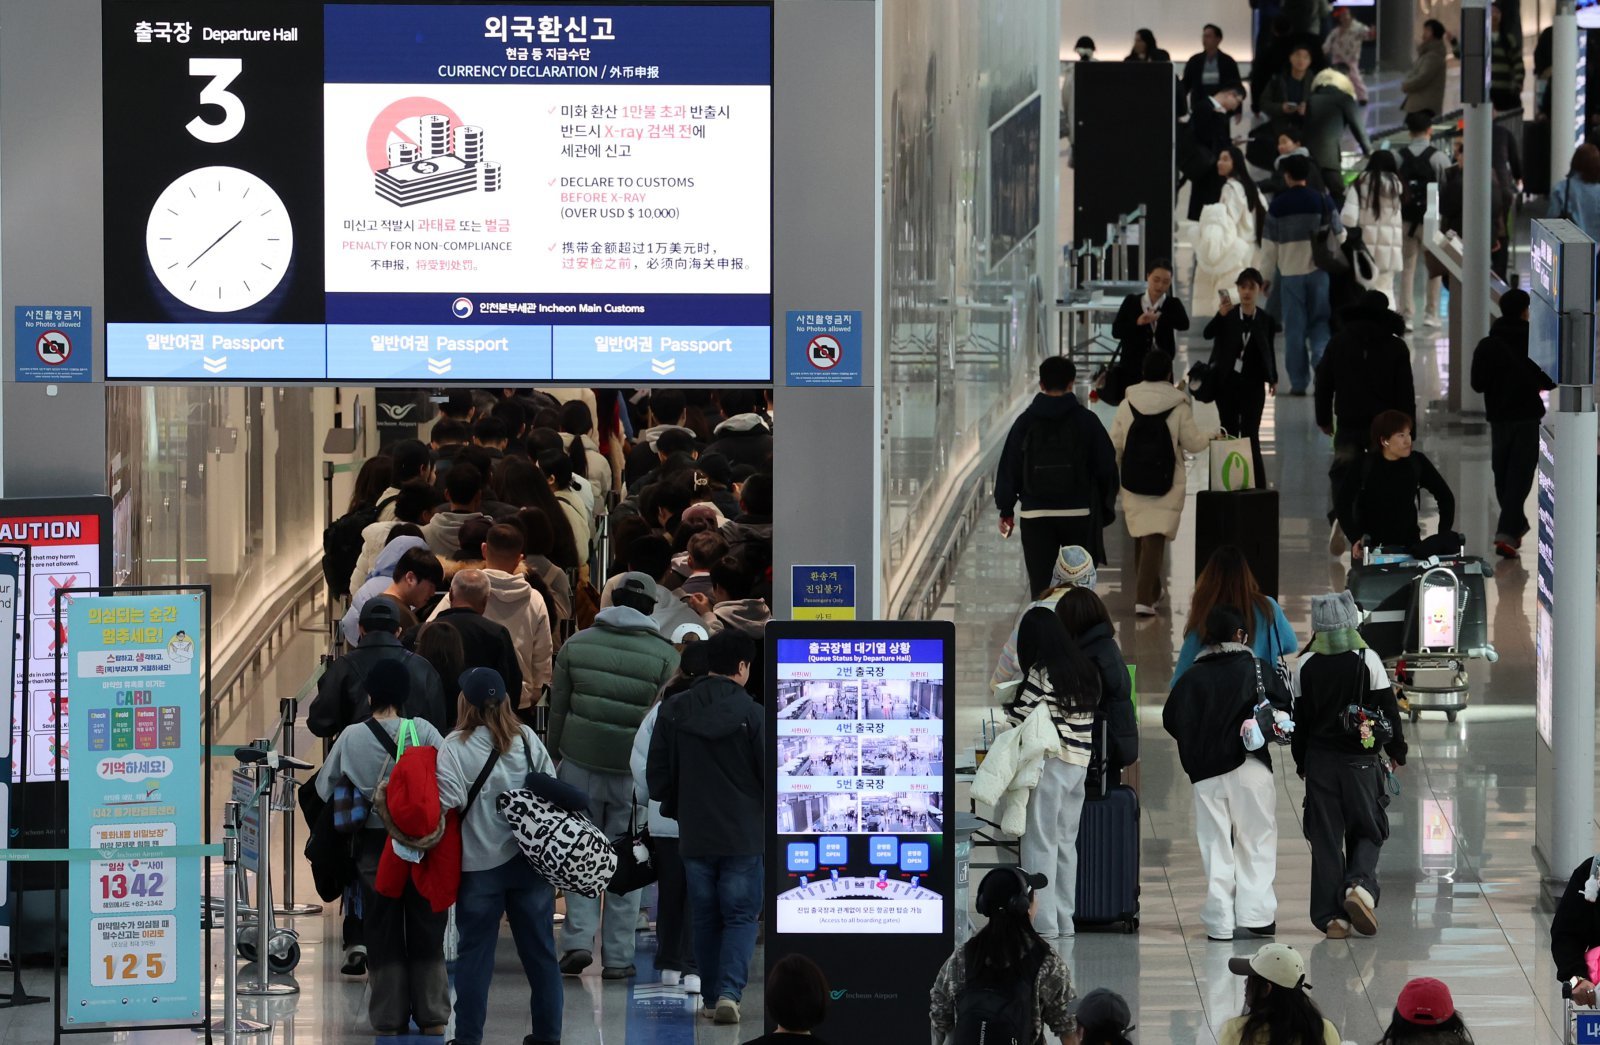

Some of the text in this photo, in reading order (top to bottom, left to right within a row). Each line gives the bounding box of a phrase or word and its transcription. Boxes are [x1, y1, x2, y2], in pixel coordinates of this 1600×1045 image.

[134, 21, 192, 43] 출국장
[484, 15, 616, 43] 외국환신고
[202, 27, 298, 44] Departure Hall
[506, 48, 591, 60] 현금 등 지급수단
[438, 65, 508, 78] CURRENCY
[510, 65, 598, 78] DECLARATION
[609, 65, 660, 79] 外币申报
[185, 57, 247, 144] 3
[561, 105, 731, 120] 미화 환산 1만불 초과 반출시
[560, 124, 706, 141] 반드시 X-ray 검색 전에
[560, 143, 632, 158] 세관에 신고
[560, 177, 695, 188] DECLARE TO CUSTOMS
[560, 192, 646, 203] BEFORE X-RAY
[560, 207, 680, 219] (OVER USD $ 10,000)
[343, 218, 511, 233] 미신고 적발시 과태료 또는 벌금
[342, 240, 512, 251] PENALTY FOR NON-COMPLIANCE
[479, 302, 645, 314] 인천본부세관 Incheon Main Customs
[25, 310, 82, 320] 사진촬영금지
[796, 315, 852, 325] 사진촬영금지
[145, 334, 284, 354] 일반여권 Passport
[370, 335, 509, 353] 일반여권 Passport
[595, 335, 732, 354] 일반여권 Passport
[810, 570, 838, 581] 환송객
[806, 584, 843, 594] 진입불가
[88, 606, 177, 624] 의심되는 순간
[102, 627, 164, 645] 멈추세요!
[809, 642, 911, 655] 출국장별 대기열 상황
[808, 655, 832, 663] (Queue
[854, 655, 862, 663] by
[863, 655, 895, 663] Departure
[895, 655, 912, 663] Hall)
[836, 667, 853, 677] 2번
[855, 667, 885, 677] 출국장
[116, 690, 152, 706] CARD
[836, 723, 853, 733] 4번
[855, 723, 885, 733] 출국장
[102, 760, 166, 775] 기억하세요!
[836, 779, 853, 789] 5번
[855, 779, 885, 789] 출국장
[147, 861, 164, 870] 사이
[100, 872, 165, 900] 1342
[97, 922, 136, 931] 마약밀수가
[856, 917, 882, 925] boarding
[882, 917, 901, 925] gates)
[102, 930, 165, 940] 밀수신고는 이리로
[874, 992, 898, 1000] Airport
